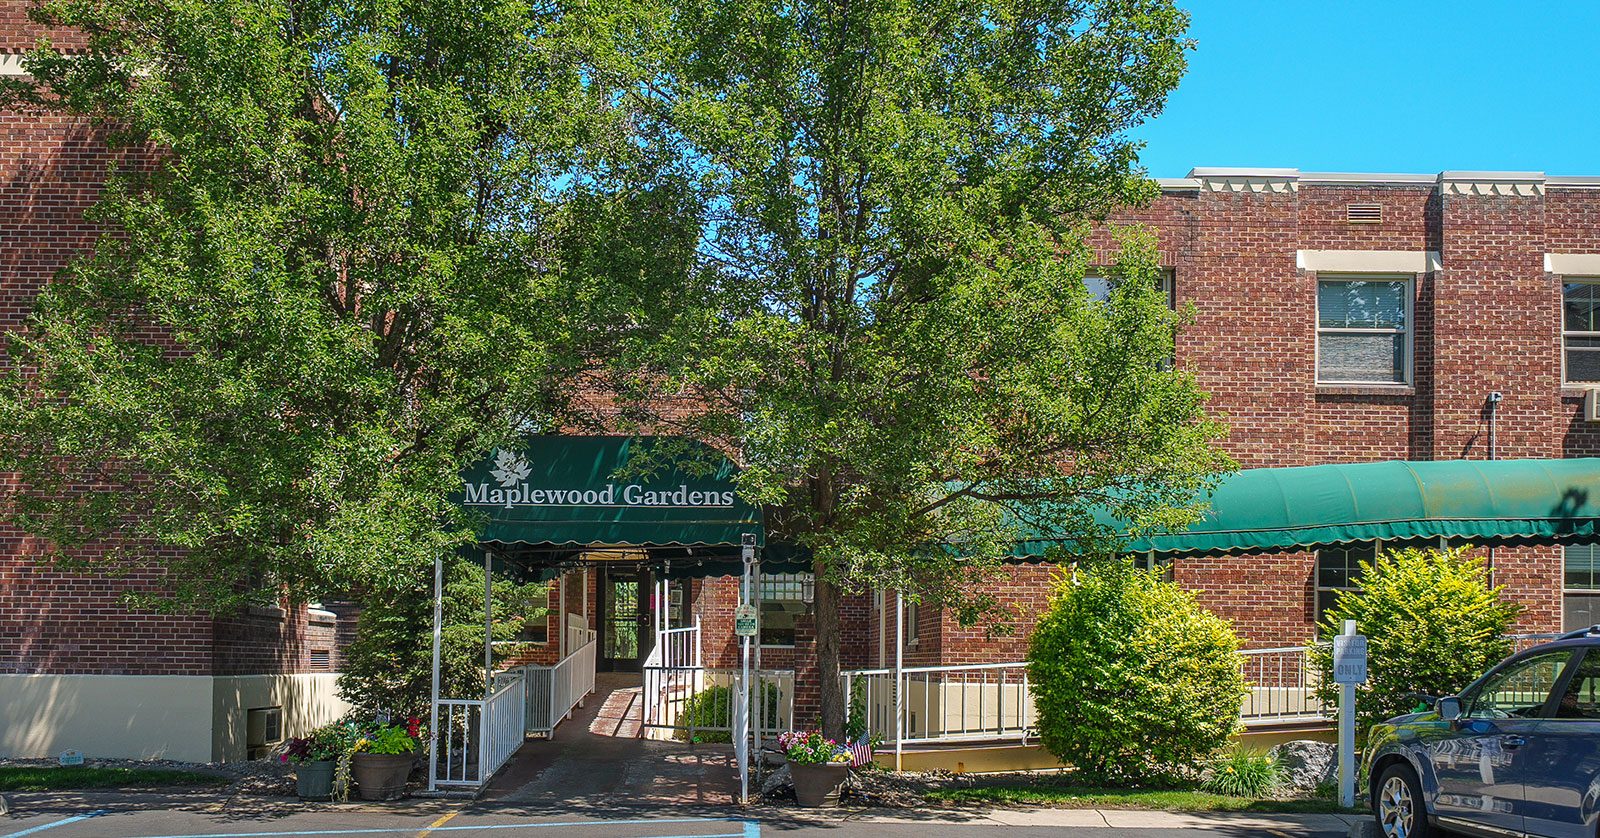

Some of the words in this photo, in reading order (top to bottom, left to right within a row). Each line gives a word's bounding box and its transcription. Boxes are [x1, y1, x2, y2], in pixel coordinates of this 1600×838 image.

[463, 483, 615, 508] Maplewood
[623, 484, 735, 507] Gardens
[1336, 647, 1365, 655] PARKING
[1337, 664, 1363, 675] ONLY
